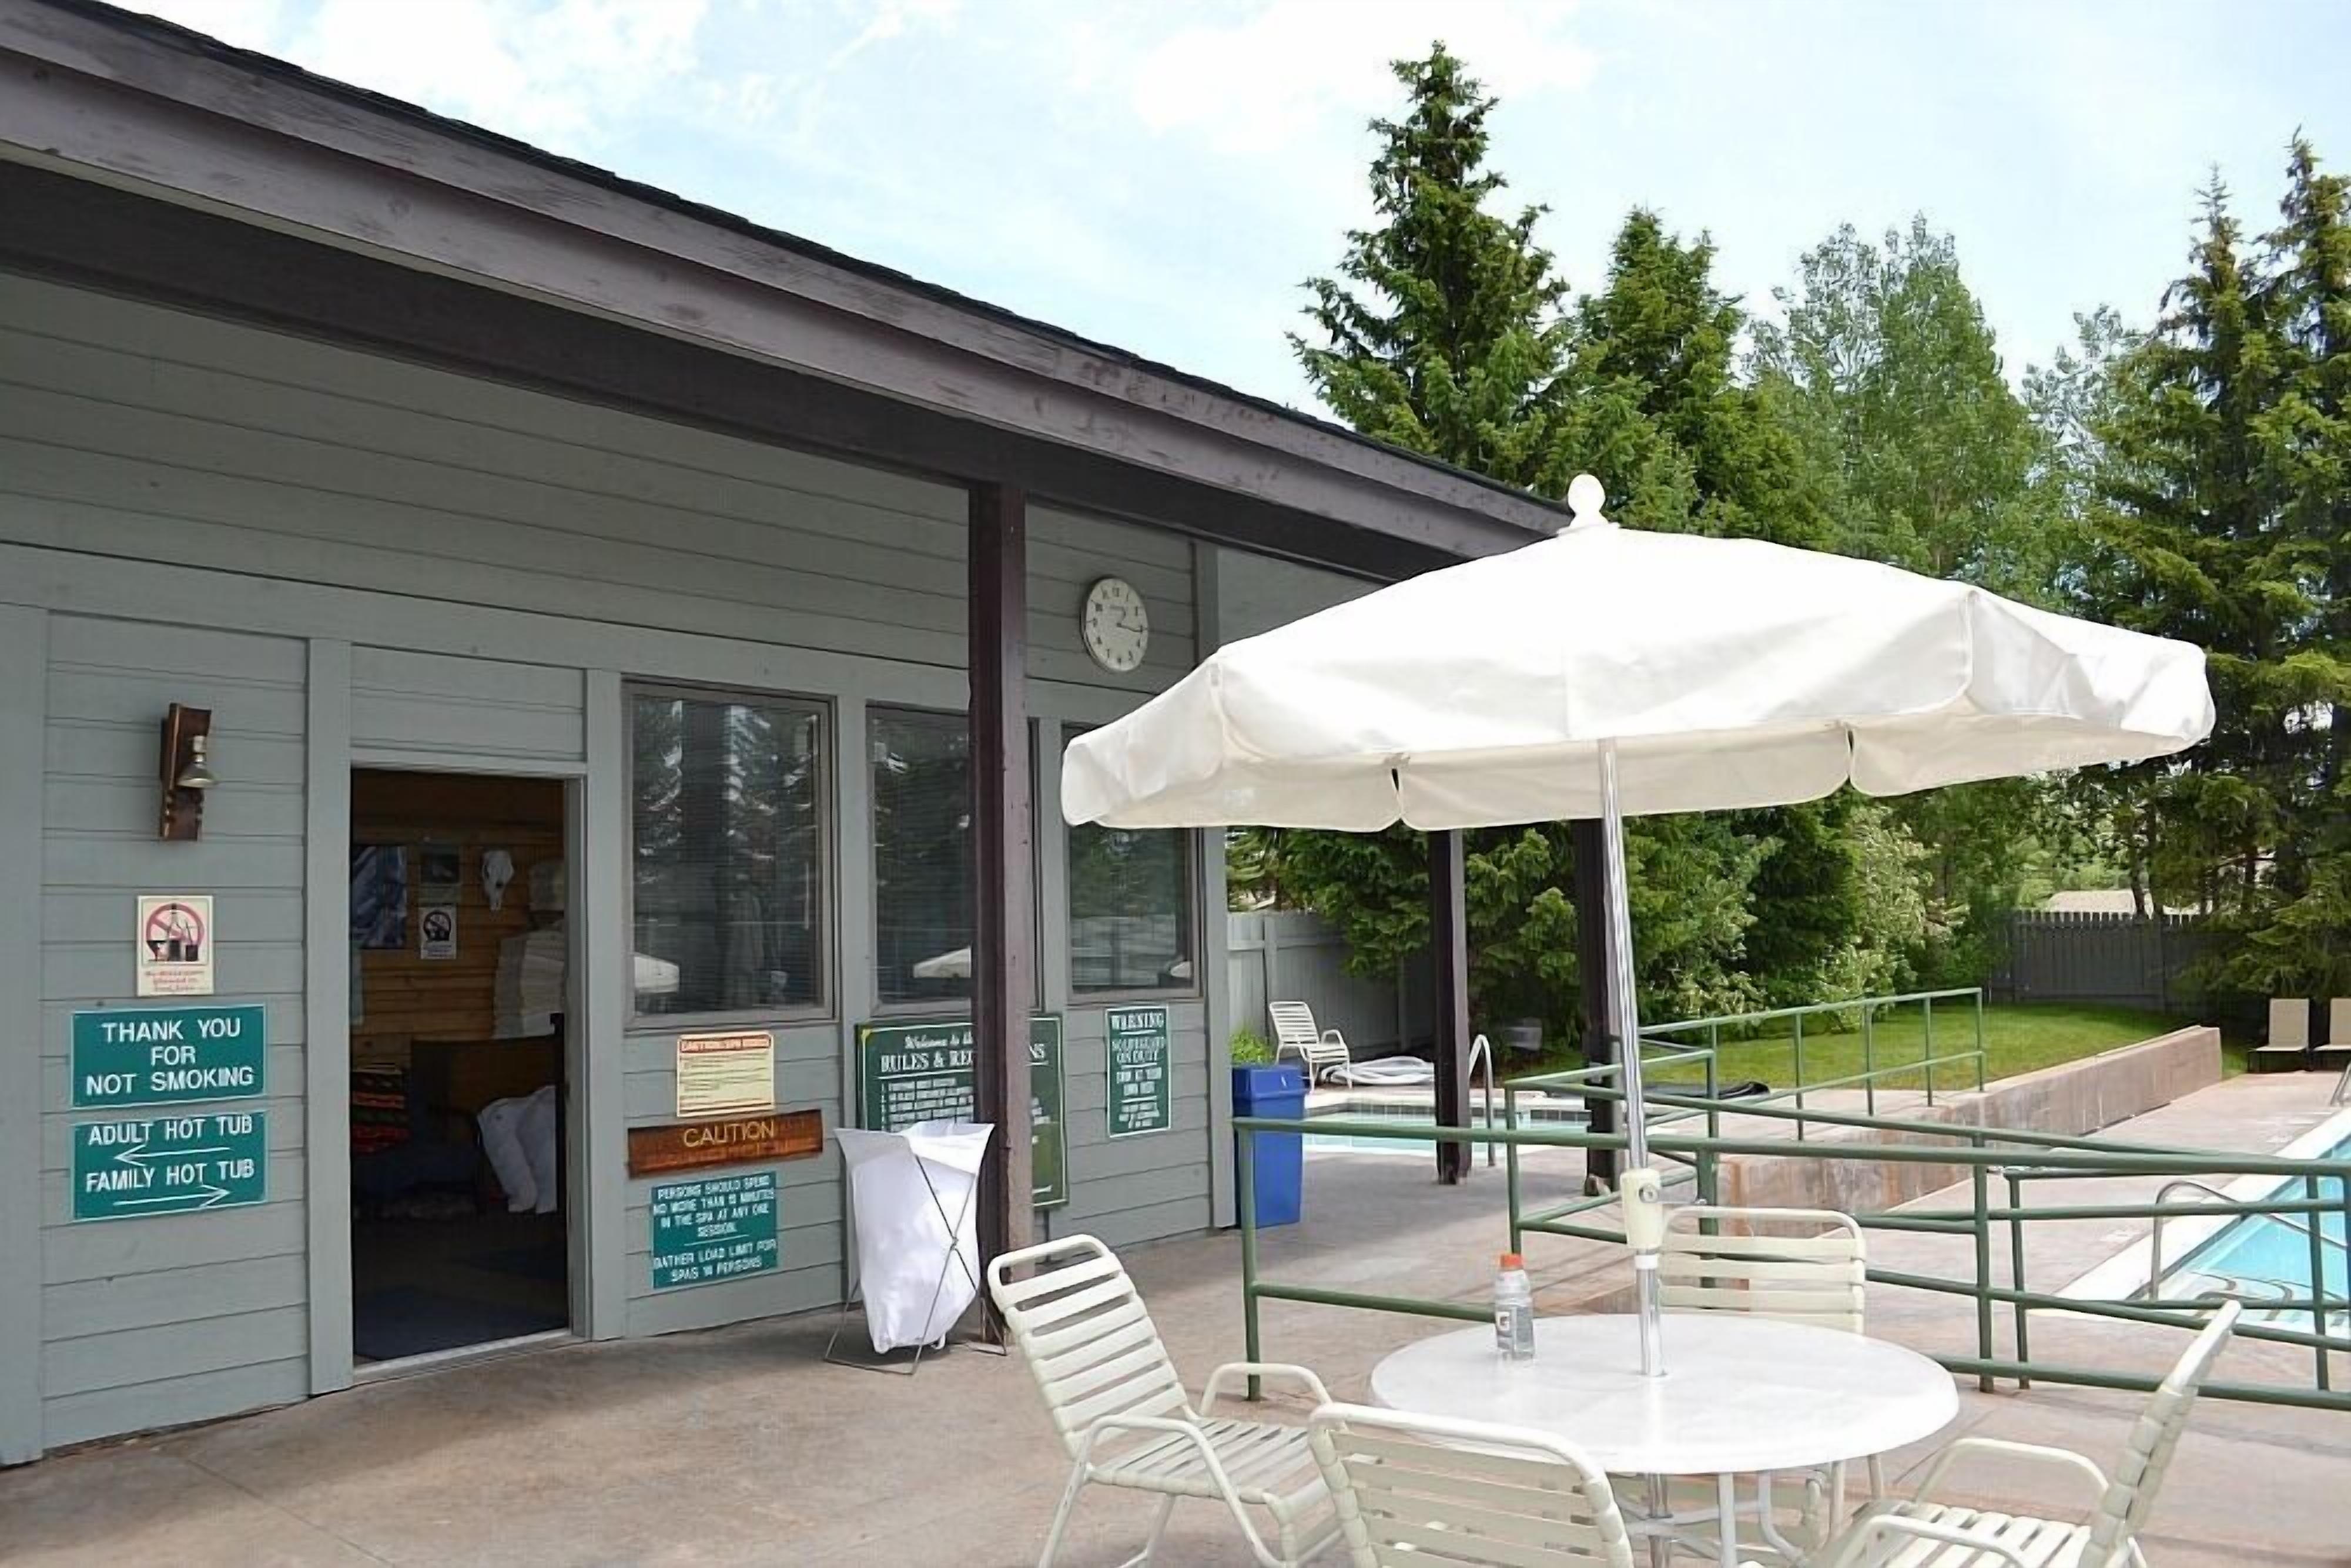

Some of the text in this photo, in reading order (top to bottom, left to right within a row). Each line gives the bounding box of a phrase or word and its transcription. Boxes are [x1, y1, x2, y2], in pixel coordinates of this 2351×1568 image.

[101, 1017, 241, 1043] THANK YOU
[150, 1046, 196, 1066] FOR
[881, 1053, 929, 1073] RULES
[86, 1066, 254, 1095] NOT SMOKING
[88, 1115, 253, 1145] ADULT HOT TUB
[684, 1118, 774, 1147] CAUTION
[86, 1158, 254, 1192] FAMILY HOT TUB
